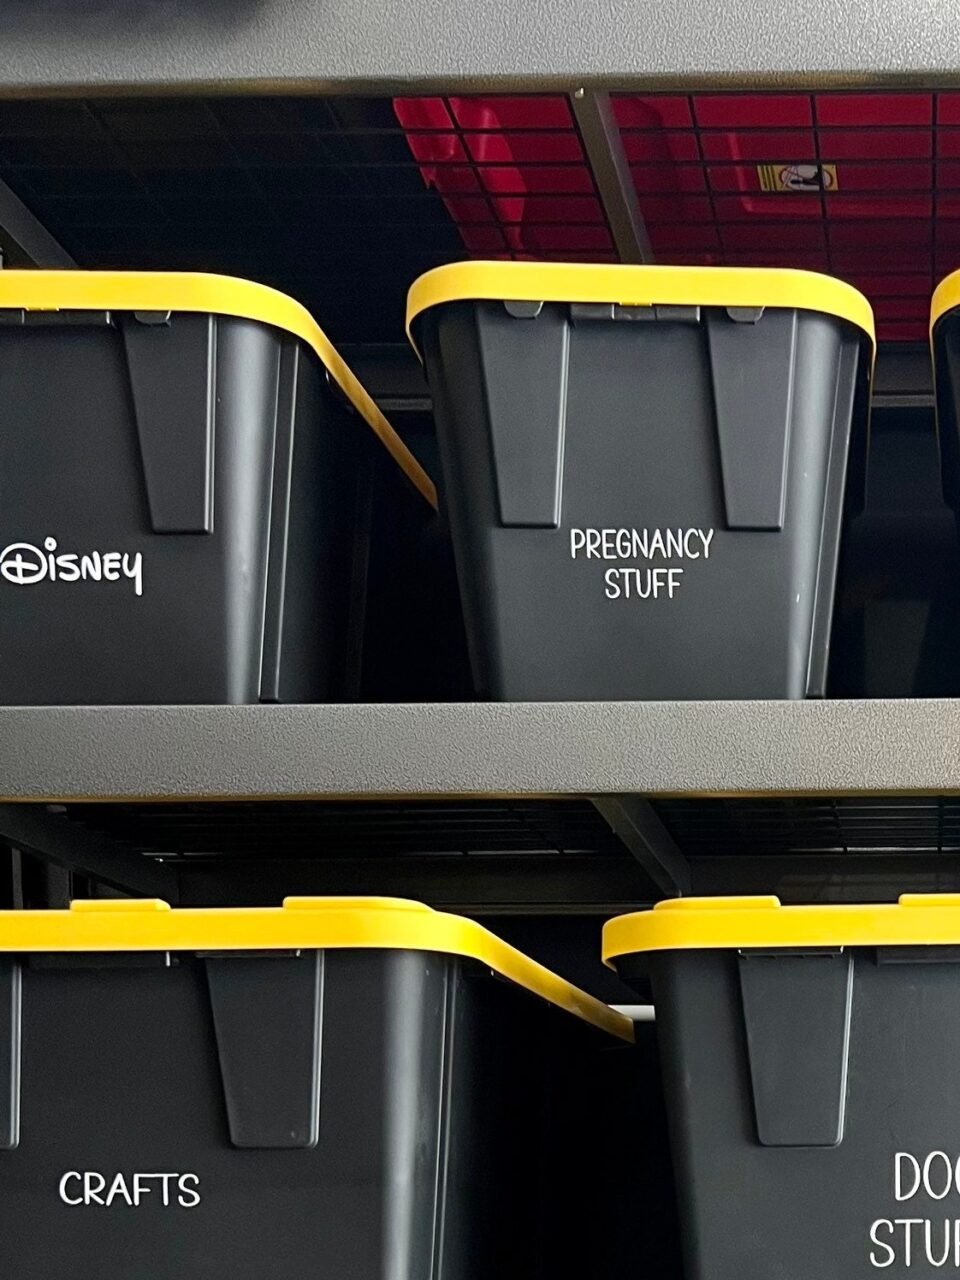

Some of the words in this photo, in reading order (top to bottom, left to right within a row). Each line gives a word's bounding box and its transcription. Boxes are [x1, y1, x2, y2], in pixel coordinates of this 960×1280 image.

[570, 527, 714, 560] PREGNANCY
[604, 568, 684, 599] STUFF
[59, 1171, 201, 1208] CRAFTS
